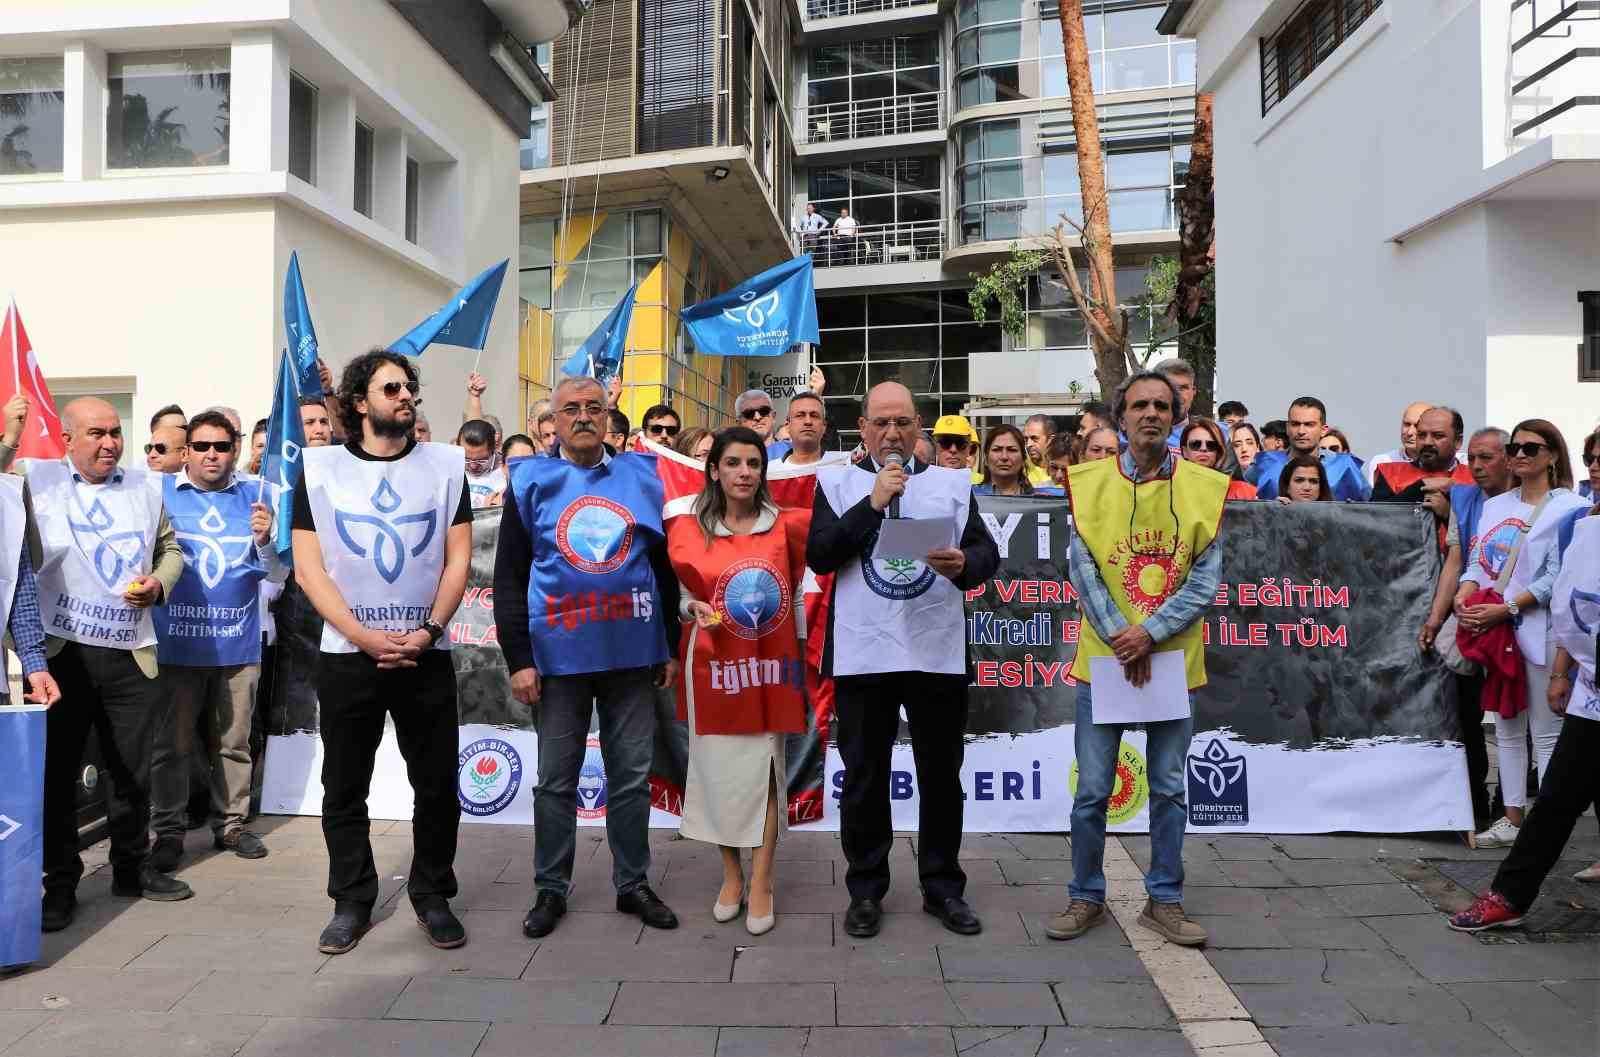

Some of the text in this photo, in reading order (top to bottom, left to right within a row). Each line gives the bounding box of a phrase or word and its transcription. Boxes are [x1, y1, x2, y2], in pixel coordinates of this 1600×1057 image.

[763, 373, 806, 386] Garanti
[1238, 577, 1350, 609] EĞİTİM
[1219, 616, 1269, 646] İLE
[1275, 617, 1348, 647] TÜM
[1191, 803, 1243, 814] HÜRRİYETÇİ
[1192, 812, 1224, 821] EĞİTİM
